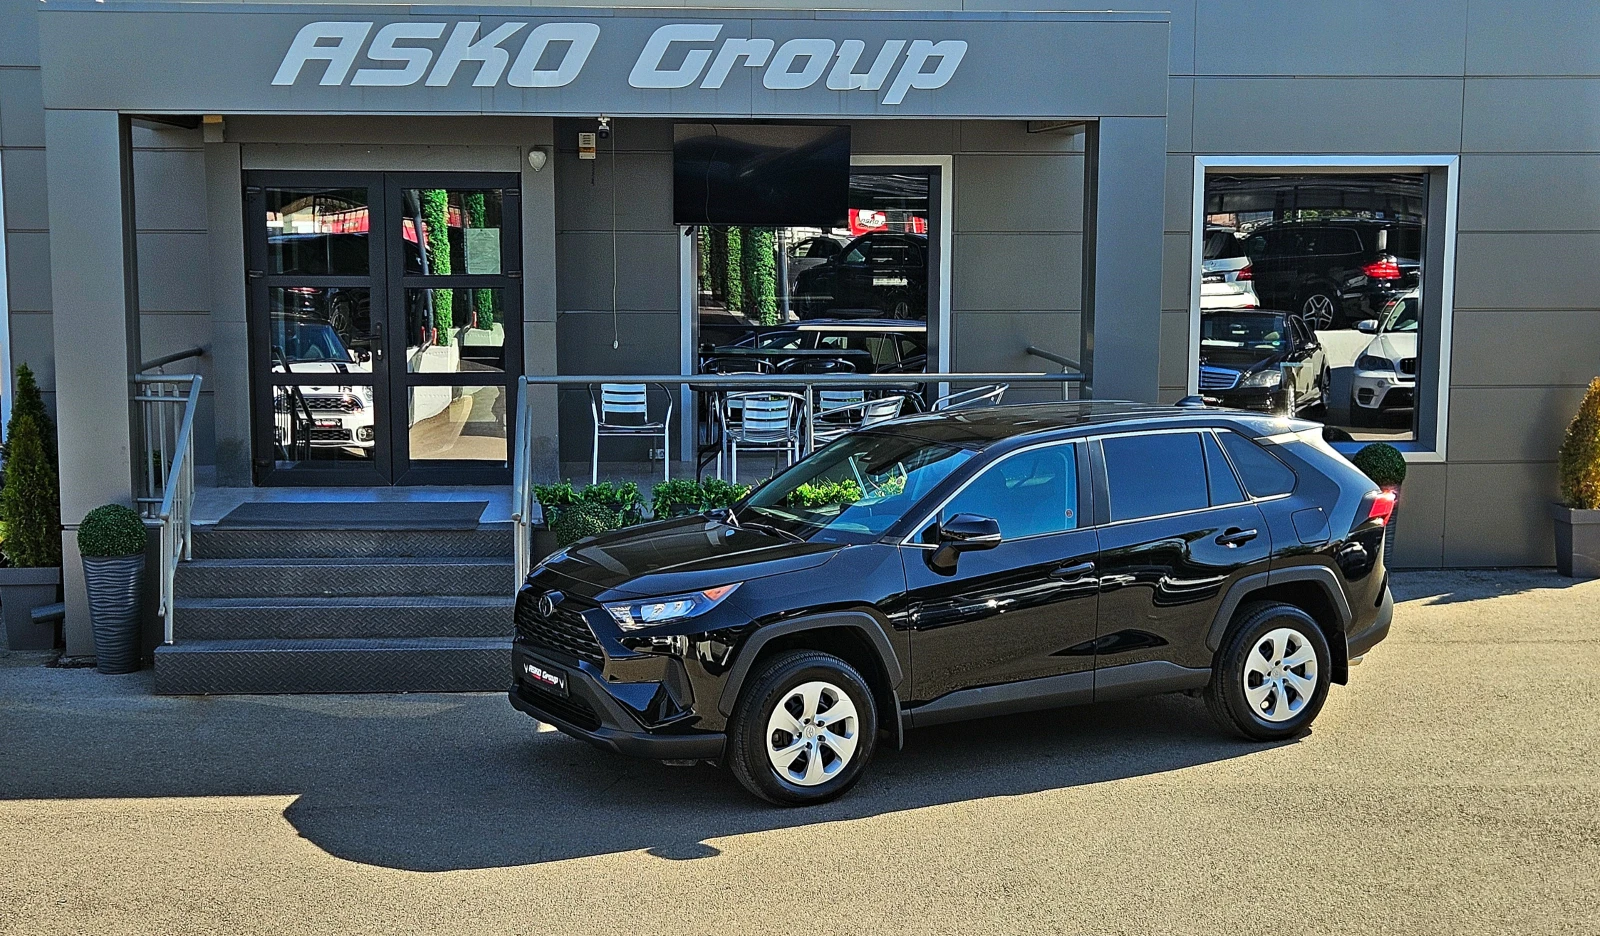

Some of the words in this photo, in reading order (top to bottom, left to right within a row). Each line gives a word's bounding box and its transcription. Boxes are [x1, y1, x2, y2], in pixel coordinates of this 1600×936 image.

[271, 21, 600, 88] ASKO
[628, 24, 968, 105] Group
[542, 670, 559, 685] Group
